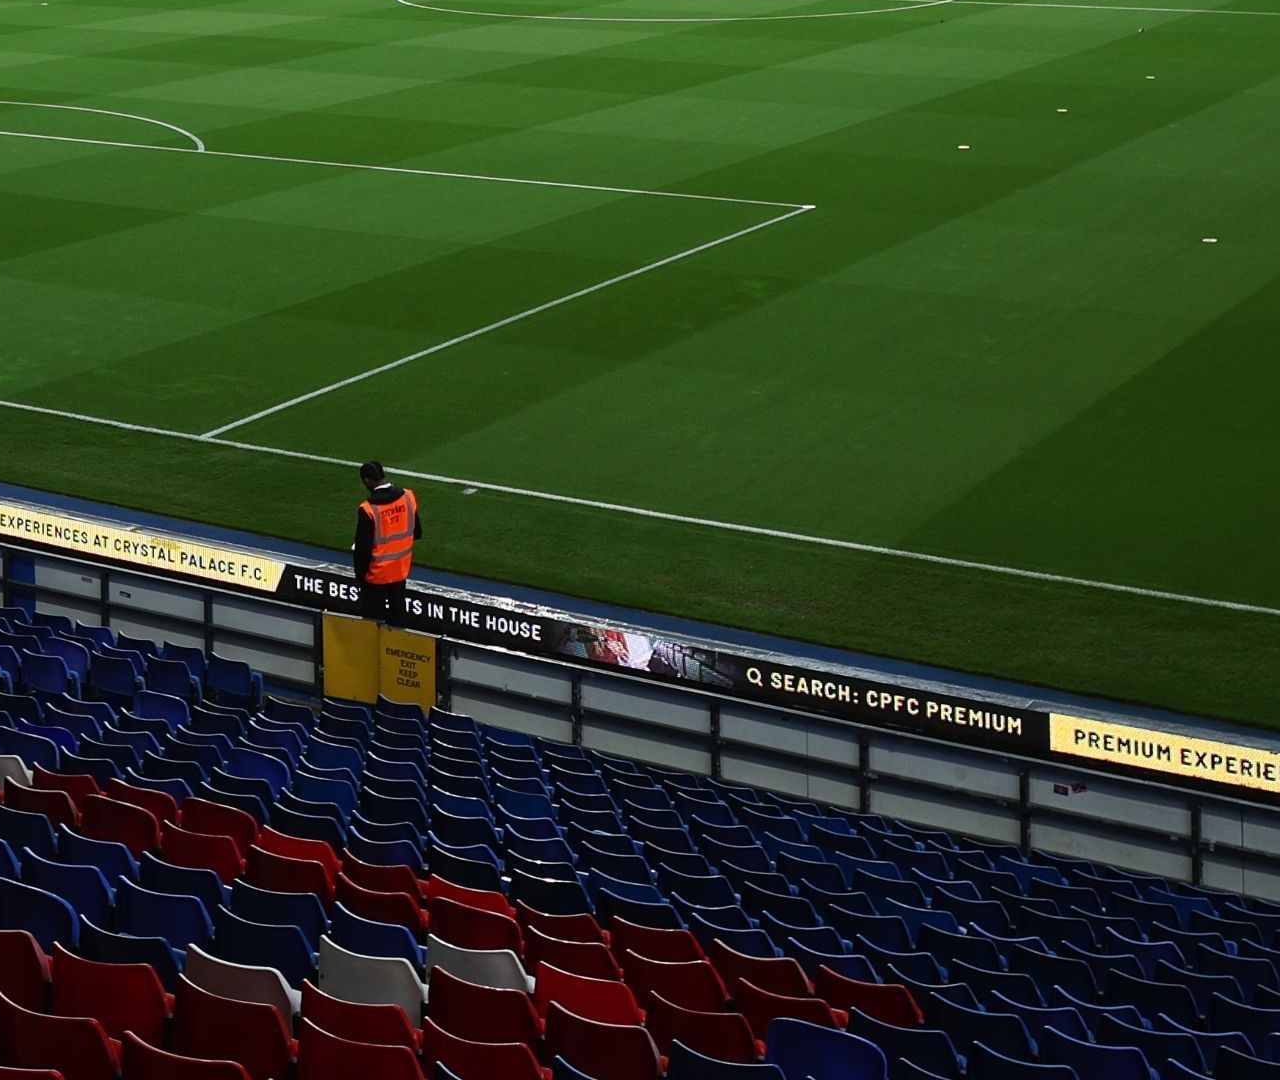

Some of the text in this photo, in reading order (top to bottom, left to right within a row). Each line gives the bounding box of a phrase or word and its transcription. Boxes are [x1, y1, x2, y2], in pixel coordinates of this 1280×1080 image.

[0, 513, 89, 545] EXPERIENCES
[93, 534, 109, 549] AT
[113, 538, 176, 563] CRYSTAL
[180, 551, 236, 576] PALACE
[241, 564, 268, 583] F.C.
[294, 574, 362, 602] THE BES
[427, 602, 444, 620] IN
[449, 607, 480, 628] THE
[485, 614, 542, 641] HOUSE
[385, 647, 431, 665] EMERGENCY
[400, 659, 417, 670] EXIT
[398, 669, 418, 679] KEEP
[770, 672, 1022, 736] SEARCH: CPFC PREMIUM
[1074, 728, 1171, 761] PREMIUM
